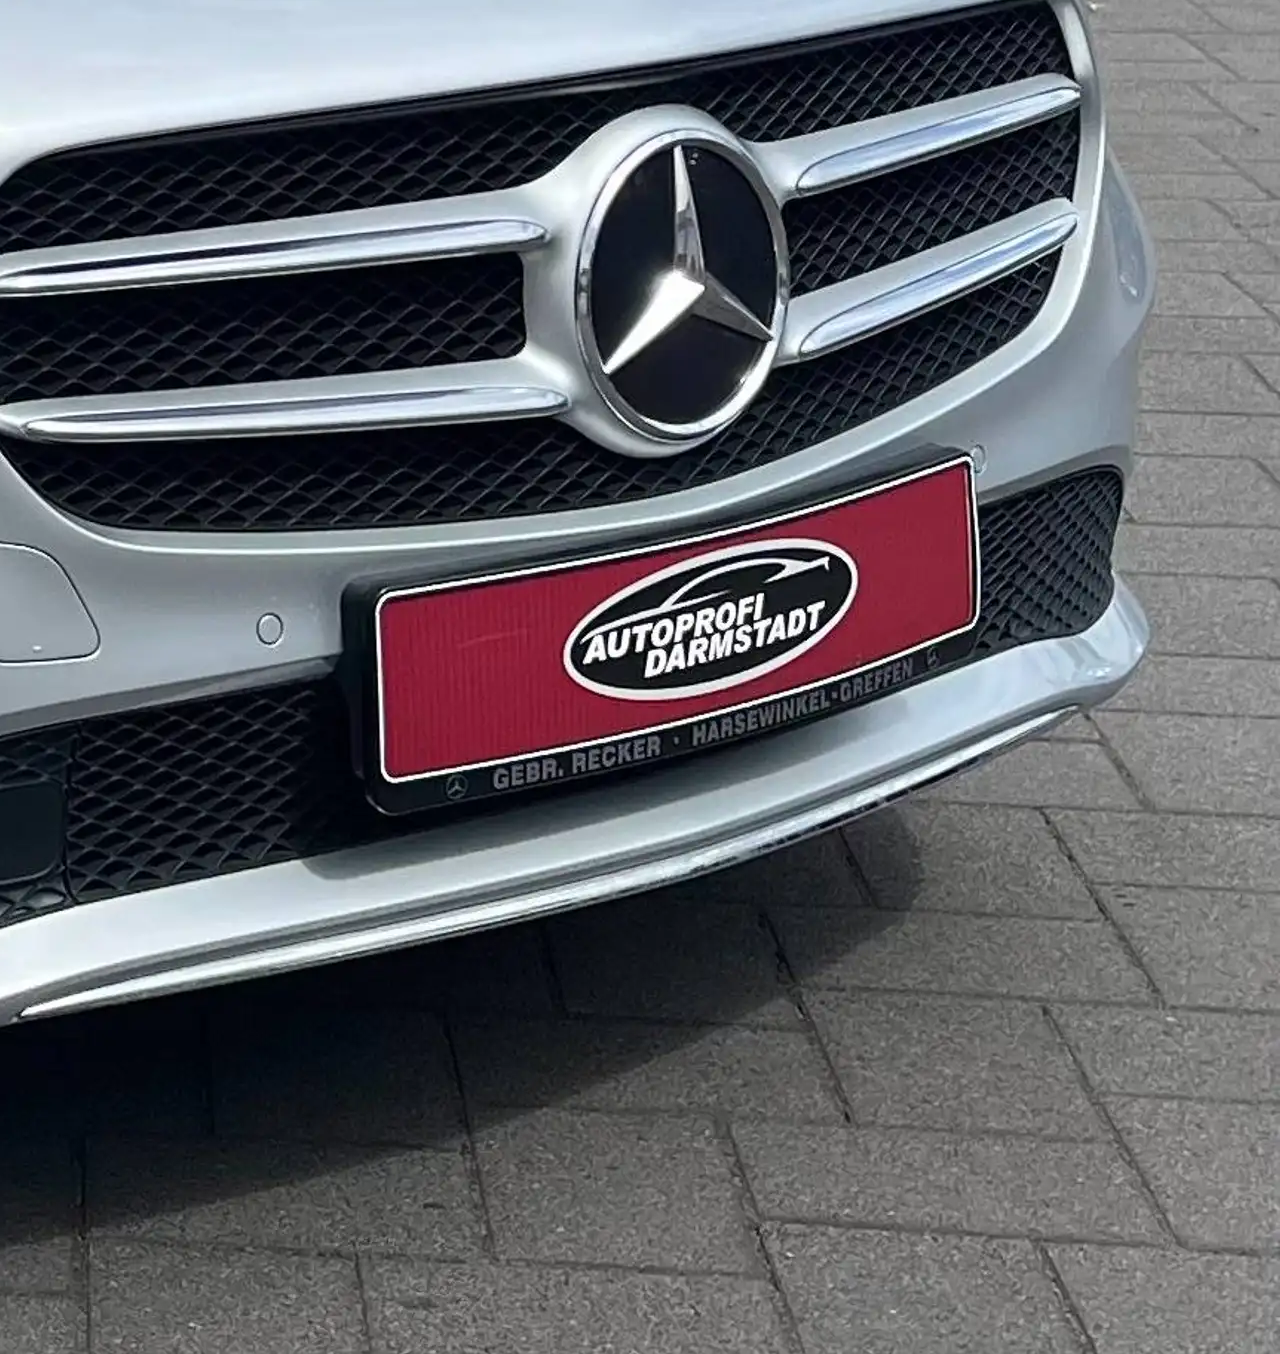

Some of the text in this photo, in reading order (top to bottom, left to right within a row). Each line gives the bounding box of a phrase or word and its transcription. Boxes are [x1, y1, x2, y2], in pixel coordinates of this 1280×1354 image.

[583, 593, 765, 665] AUTOPROFI
[644, 600, 826, 679] DARMSTADT
[493, 758, 564, 790] GEBR.
[572, 735, 662, 775] RECKER
